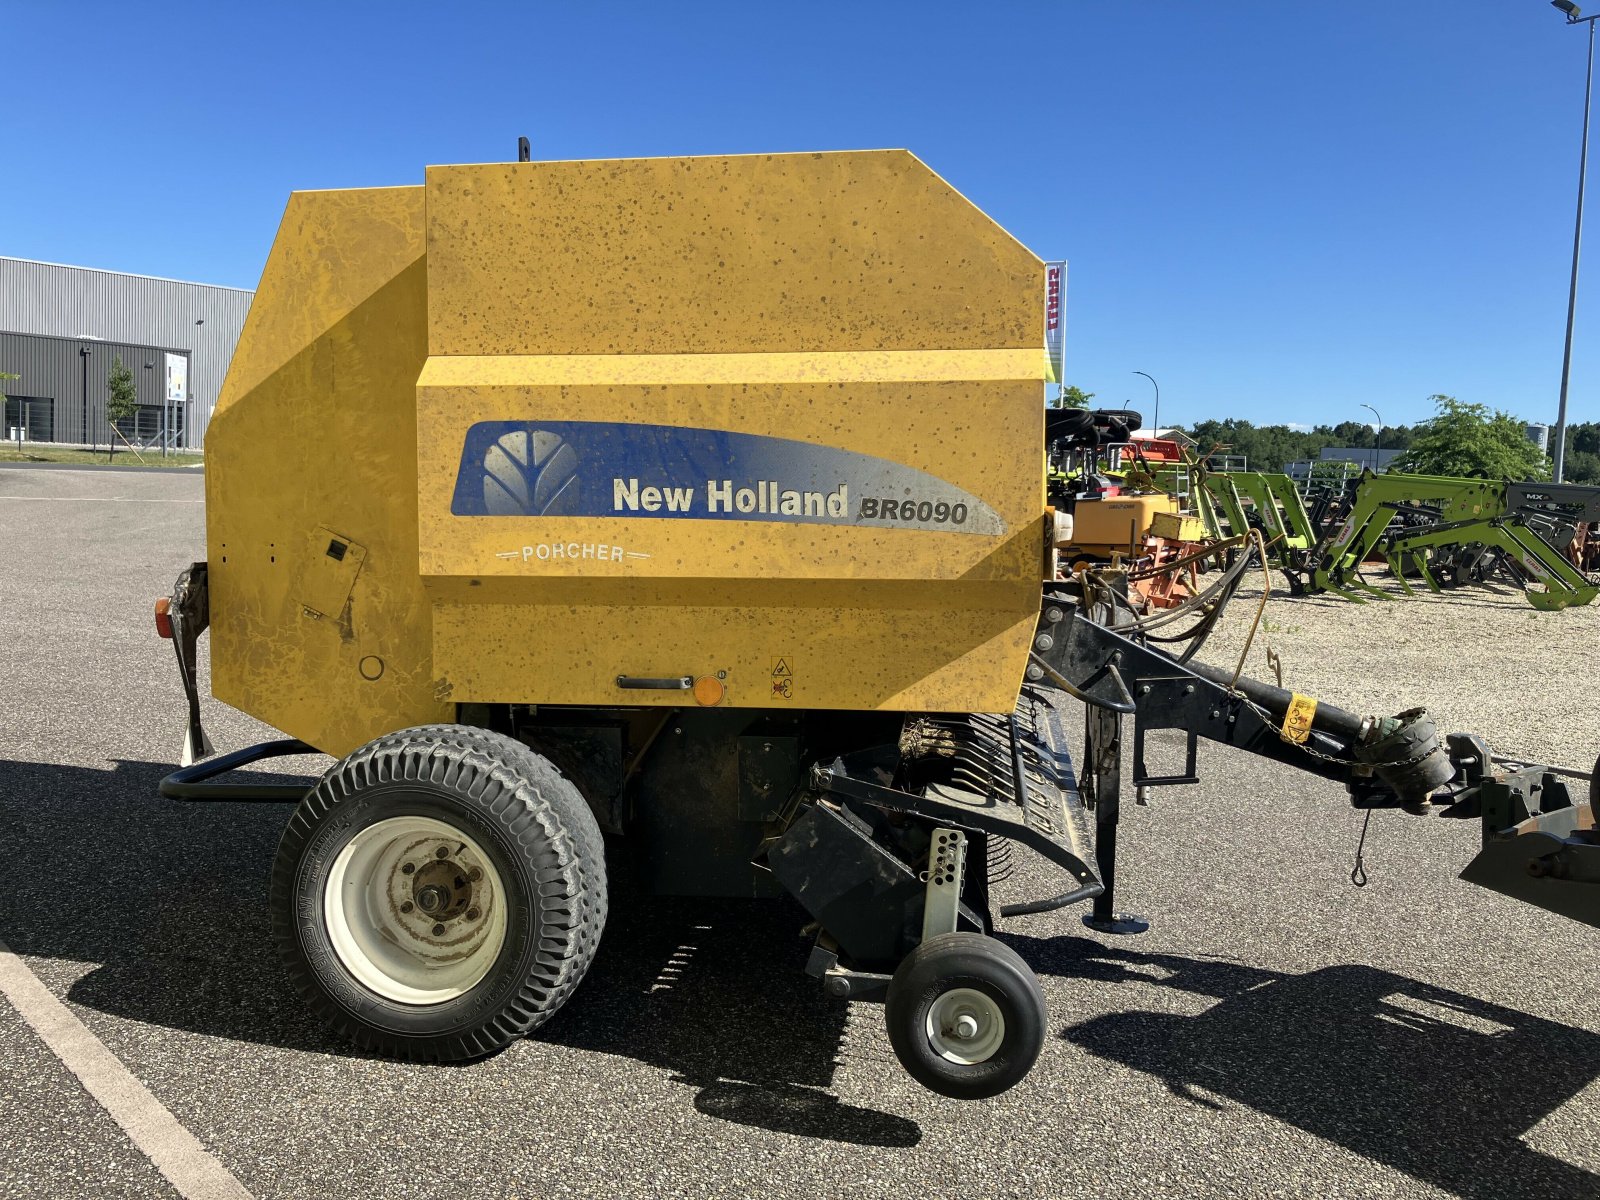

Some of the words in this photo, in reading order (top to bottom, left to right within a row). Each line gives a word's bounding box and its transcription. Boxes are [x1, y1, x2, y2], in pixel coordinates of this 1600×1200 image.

[613, 478, 694, 512] New
[707, 480, 848, 518] Holland
[860, 497, 968, 524] BR6090
[1338, 525, 1351, 543] CLAAS
[522, 543, 624, 562] PORCHER
[1526, 558, 1541, 573] CLAAS
